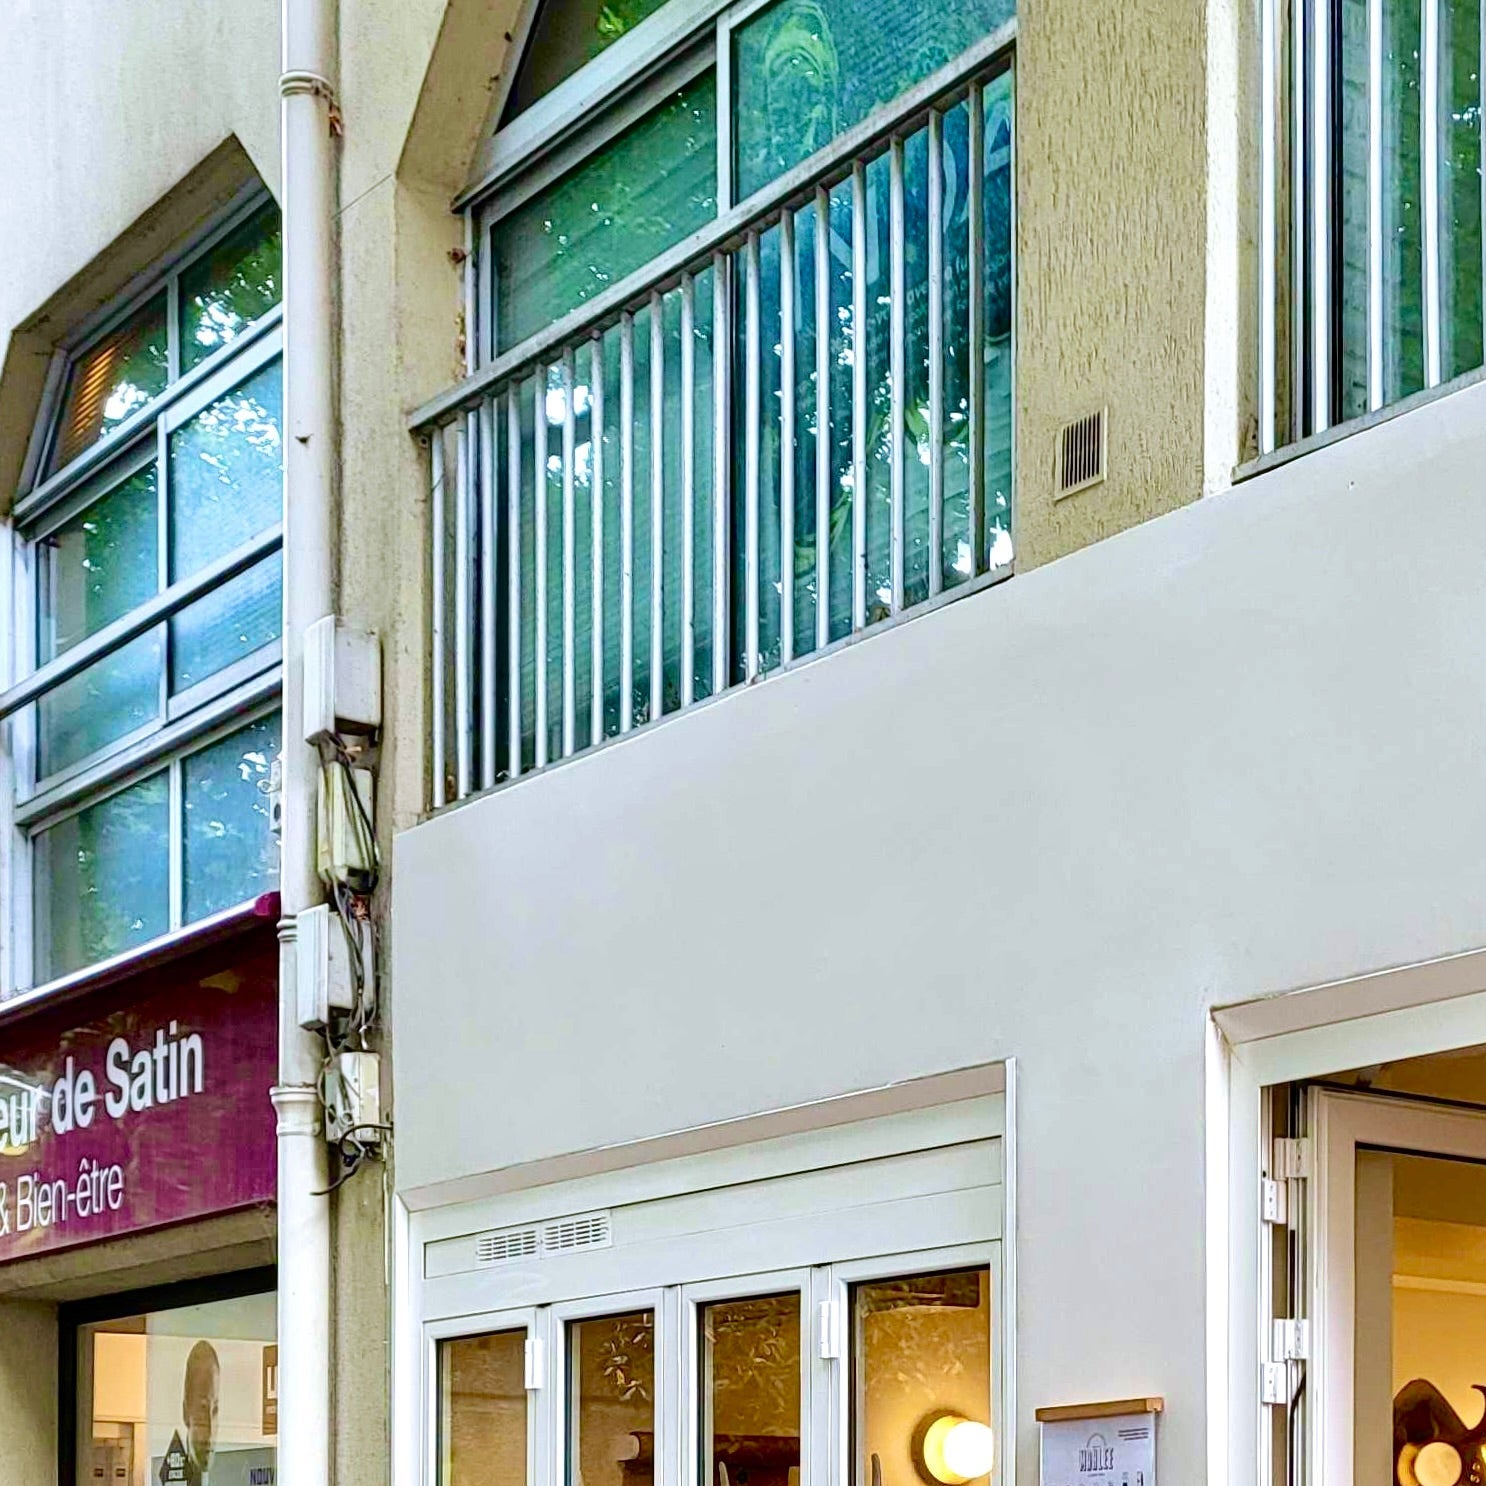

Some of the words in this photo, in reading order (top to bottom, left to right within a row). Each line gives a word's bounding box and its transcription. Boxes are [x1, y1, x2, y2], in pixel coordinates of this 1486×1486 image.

[52, 1056, 95, 1135] de
[105, 1020, 203, 1119] Satin
[17, 1157, 124, 1232] Bien-être
